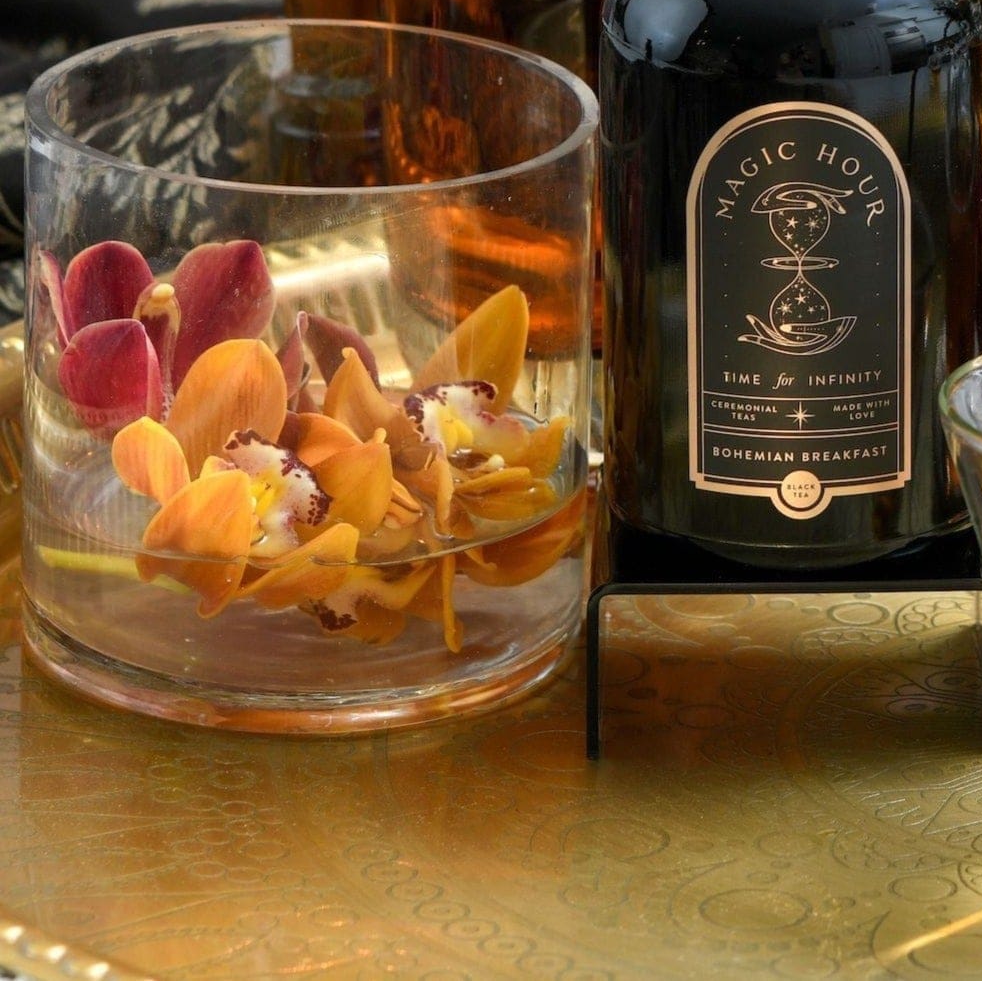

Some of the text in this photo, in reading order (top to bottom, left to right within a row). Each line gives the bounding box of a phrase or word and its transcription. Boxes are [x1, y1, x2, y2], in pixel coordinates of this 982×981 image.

[715, 141, 885, 227] MAGIC HOUR
[723, 369, 882, 390] TIME for INFINITY
[711, 400, 778, 414] CEREMONIAL
[833, 399, 890, 412] MADE WITH
[731, 412, 756, 421] TEAS
[849, 410, 875, 420] LOVE
[712, 445, 888, 462] BOHEMIAN BREAKFAST
